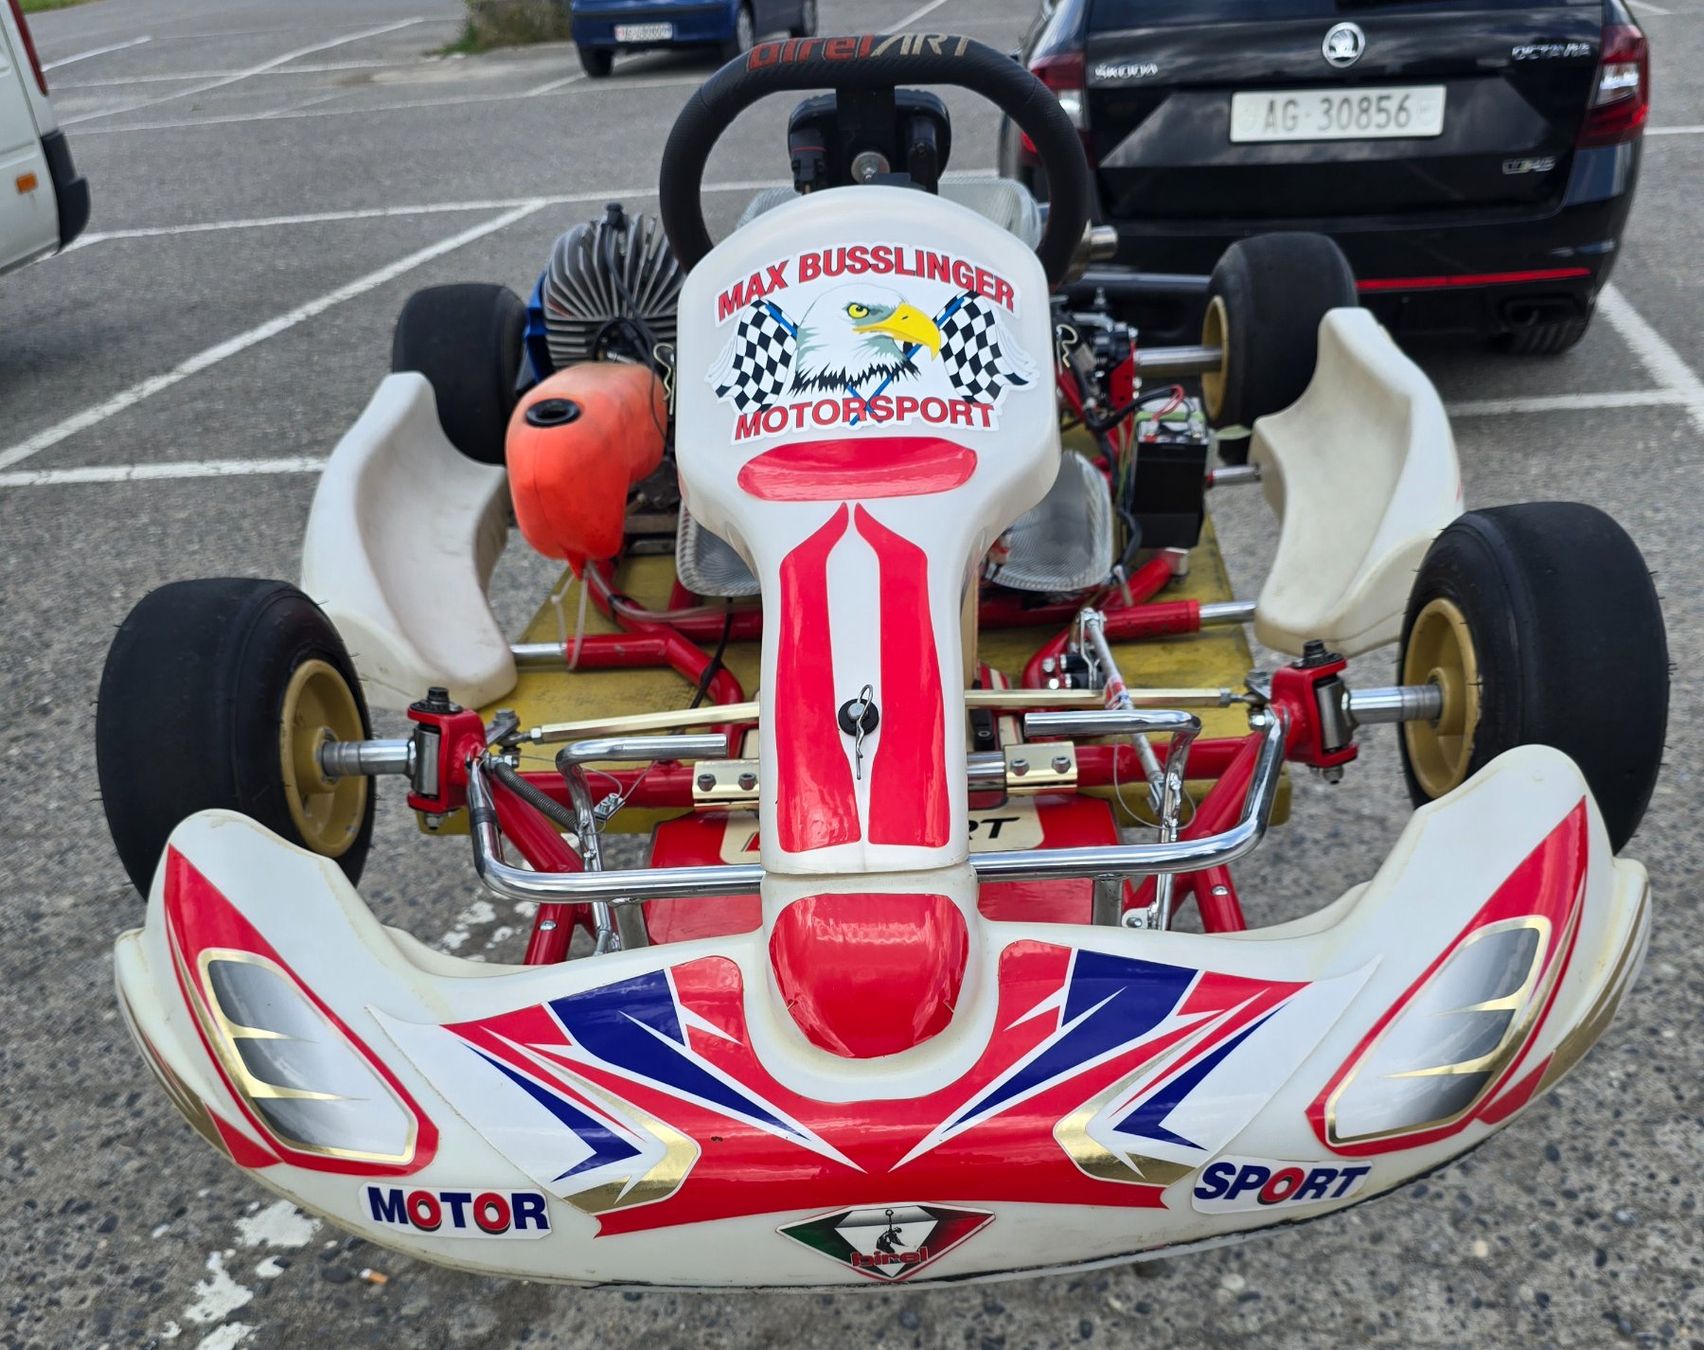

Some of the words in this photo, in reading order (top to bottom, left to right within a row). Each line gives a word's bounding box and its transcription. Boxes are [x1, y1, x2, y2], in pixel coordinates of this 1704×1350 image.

[1262, 99, 1299, 133] AG
[1317, 94, 1411, 131] 30856
[718, 260, 790, 322] MAX
[799, 245, 1016, 313] BUSSLINGER
[734, 395, 995, 440] MOTORSPORT
[1193, 1161, 1372, 1206] SPORT
[367, 1186, 550, 1235] MOTOR
[850, 1246, 929, 1268] birel
